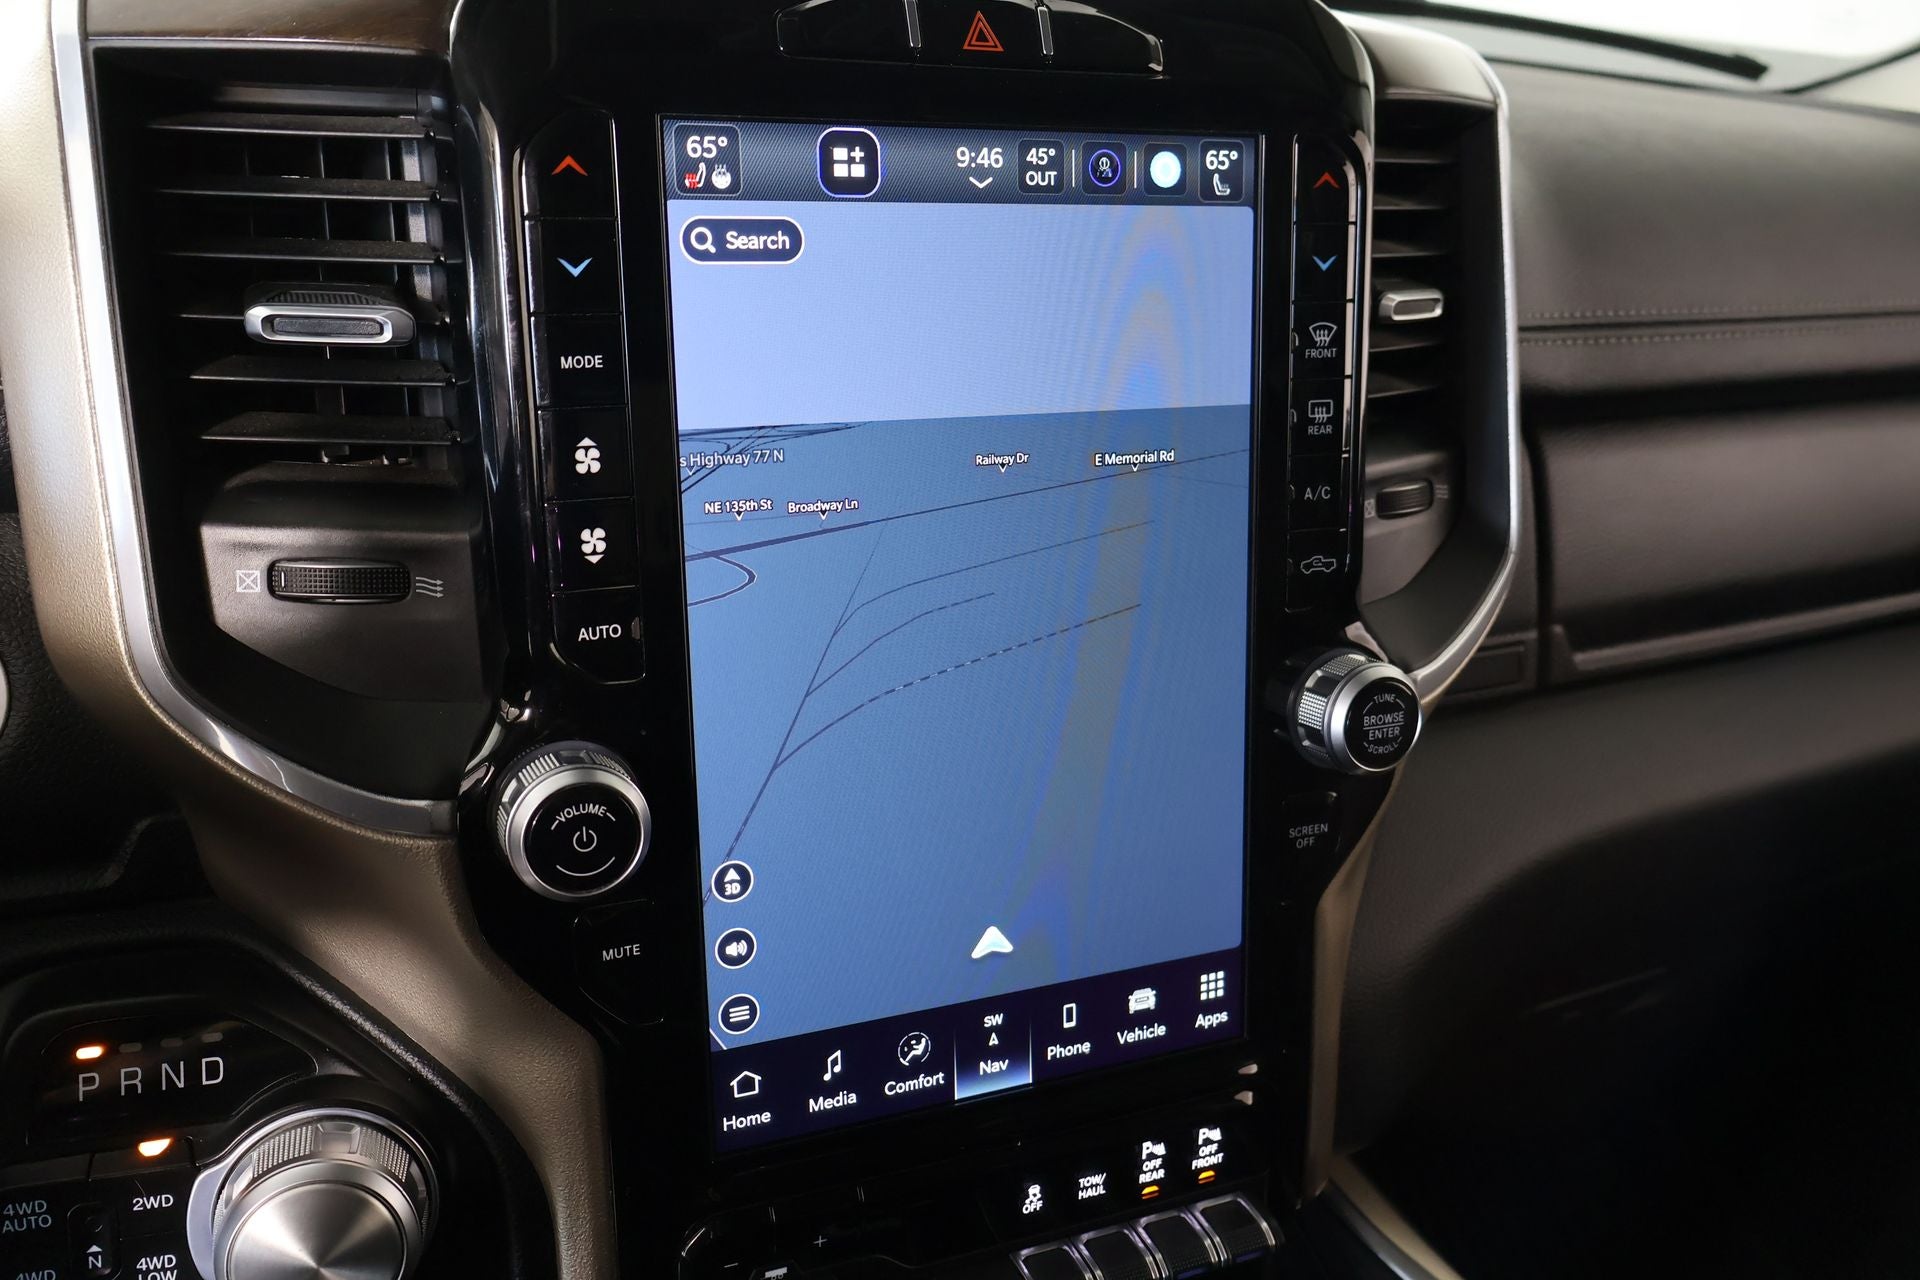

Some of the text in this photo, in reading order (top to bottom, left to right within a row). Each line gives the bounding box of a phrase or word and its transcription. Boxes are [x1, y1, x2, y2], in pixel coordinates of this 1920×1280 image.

[686, 135, 728, 158] 65°
[956, 147, 1003, 169] 9:46
[1025, 147, 1056, 165] 45°
[1205, 149, 1238, 171] 65°
[1025, 170, 1057, 186] OUT
[725, 230, 790, 250] Search
[1305, 348, 1337, 358] FRONT
[560, 355, 604, 369] MODE
[1307, 425, 1333, 435] REAR
[690, 451, 751, 469] Highway
[753, 451, 770, 463] 77
[773, 449, 784, 461] N
[976, 453, 1030, 466] Railway Dr
[1095, 450, 1175, 466] E Memorial Rd
[1304, 486, 1331, 500] A/C
[704, 499, 773, 514] NE 135th St
[788, 500, 858, 514] Broadway Ln
[577, 624, 622, 641] AUTO
[1373, 693, 1396, 704] TUNE
[1363, 711, 1405, 726] BROWSE
[1368, 726, 1400, 740] ENTER
[1367, 741, 1399, 754] SCROLL
[556, 803, 607, 822] VOLUME
[1289, 822, 1328, 838] SCREEN
[1296, 836, 1315, 848] OFF
[724, 882, 741, 895] 3D
[602, 944, 641, 961] MUTE
[983, 1013, 1004, 1028] SW
[1194, 1010, 1228, 1030] Apps
[1117, 1023, 1167, 1045] Vehicle
[1047, 1041, 1091, 1060] Phone
[979, 1059, 1009, 1075] Nav
[78, 1056, 224, 1102] P R N D
[884, 1071, 945, 1096] Comfort
[808, 1091, 857, 1113] Media
[723, 1111, 772, 1132] Home
[1198, 1144, 1219, 1157] OFF
[1142, 1158, 1163, 1172] OFF
[1191, 1152, 1225, 1171] FRONT
[1078, 1172, 1107, 1189] TOW/
[1138, 1168, 1165, 1184] REAR
[1078, 1183, 1107, 1200] HAUL
[3, 1200, 47, 1217] 4WD
[132, 1194, 174, 1211] 2WD
[1022, 1200, 1044, 1214] OFF
[2, 1214, 52, 1234] AUTO
[88, 1255, 102, 1269] N
[136, 1254, 177, 1271] 4WD
